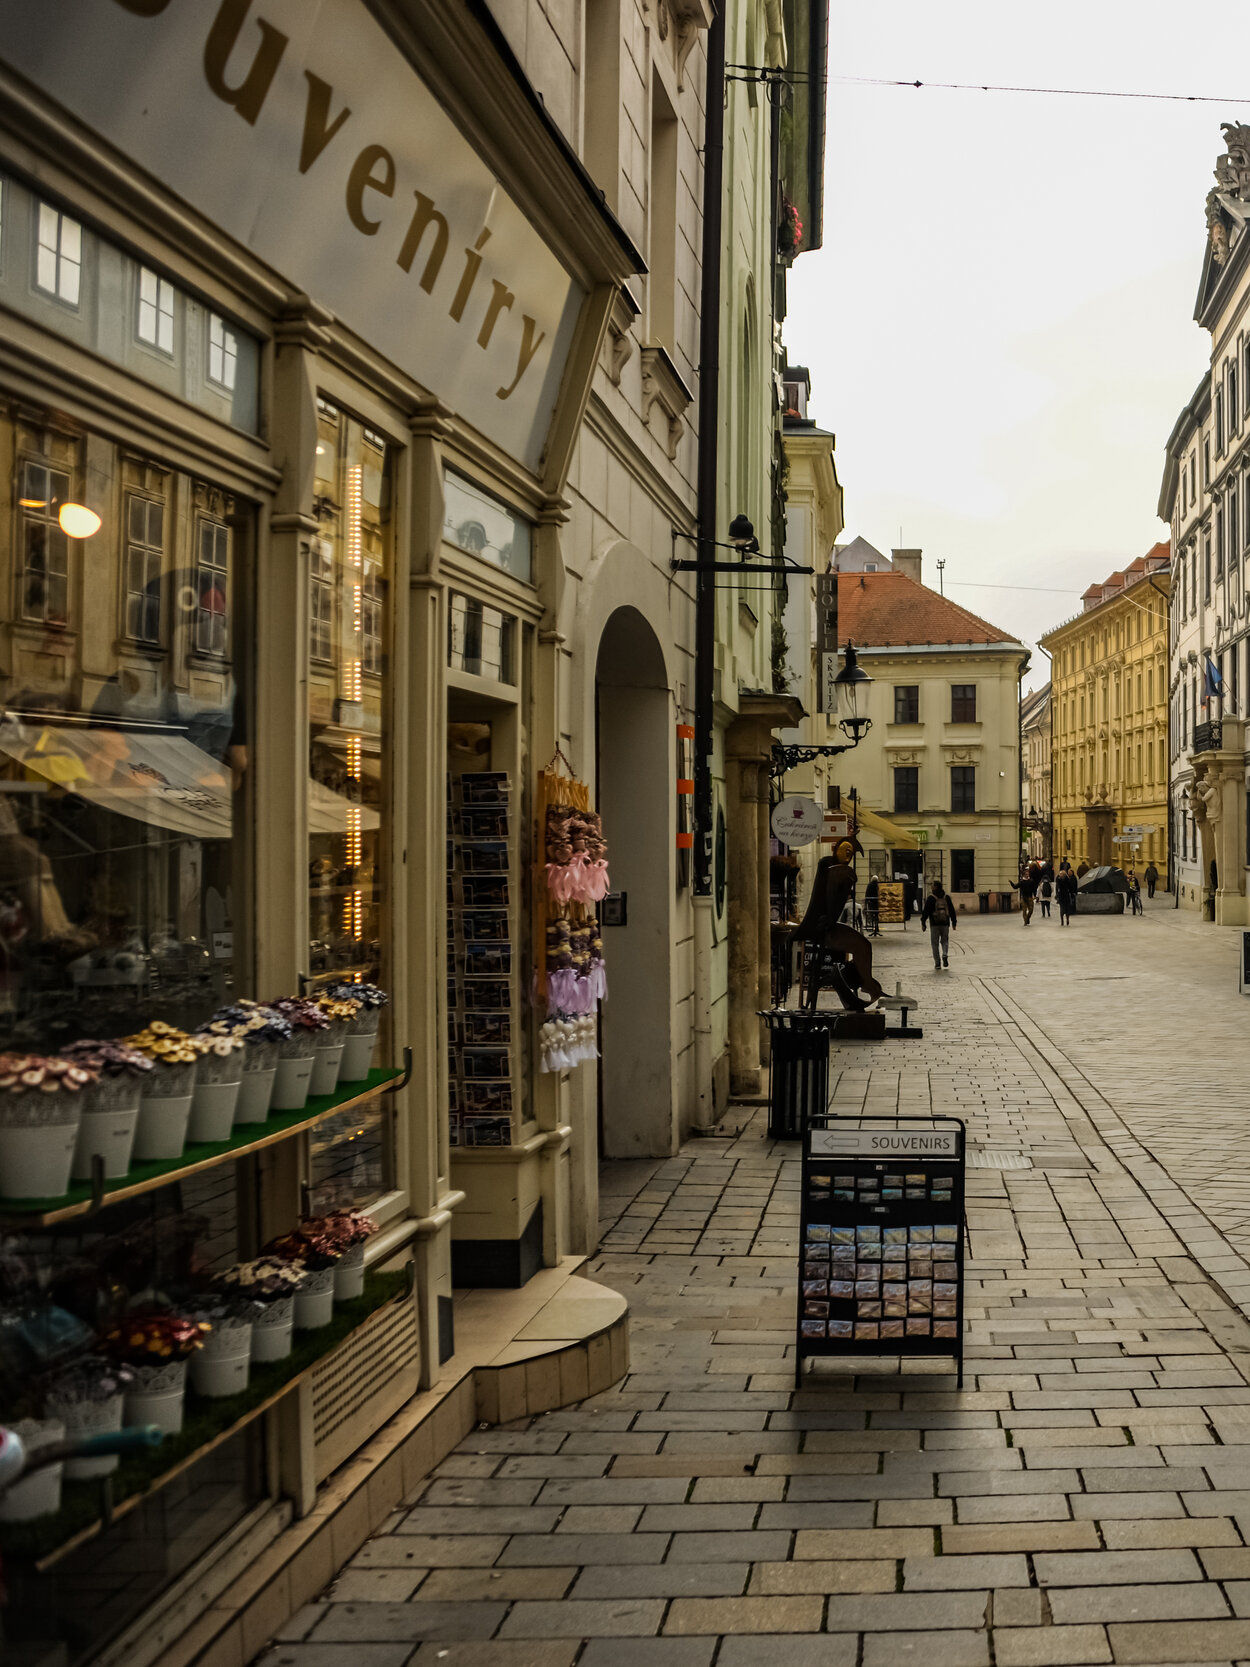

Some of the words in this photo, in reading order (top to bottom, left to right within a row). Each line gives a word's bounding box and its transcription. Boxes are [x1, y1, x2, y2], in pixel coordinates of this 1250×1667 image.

[111, 0, 546, 400] uveníry
[821, 579, 833, 649] HOTEL
[871, 1137, 951, 1150] SOUVENIRS
